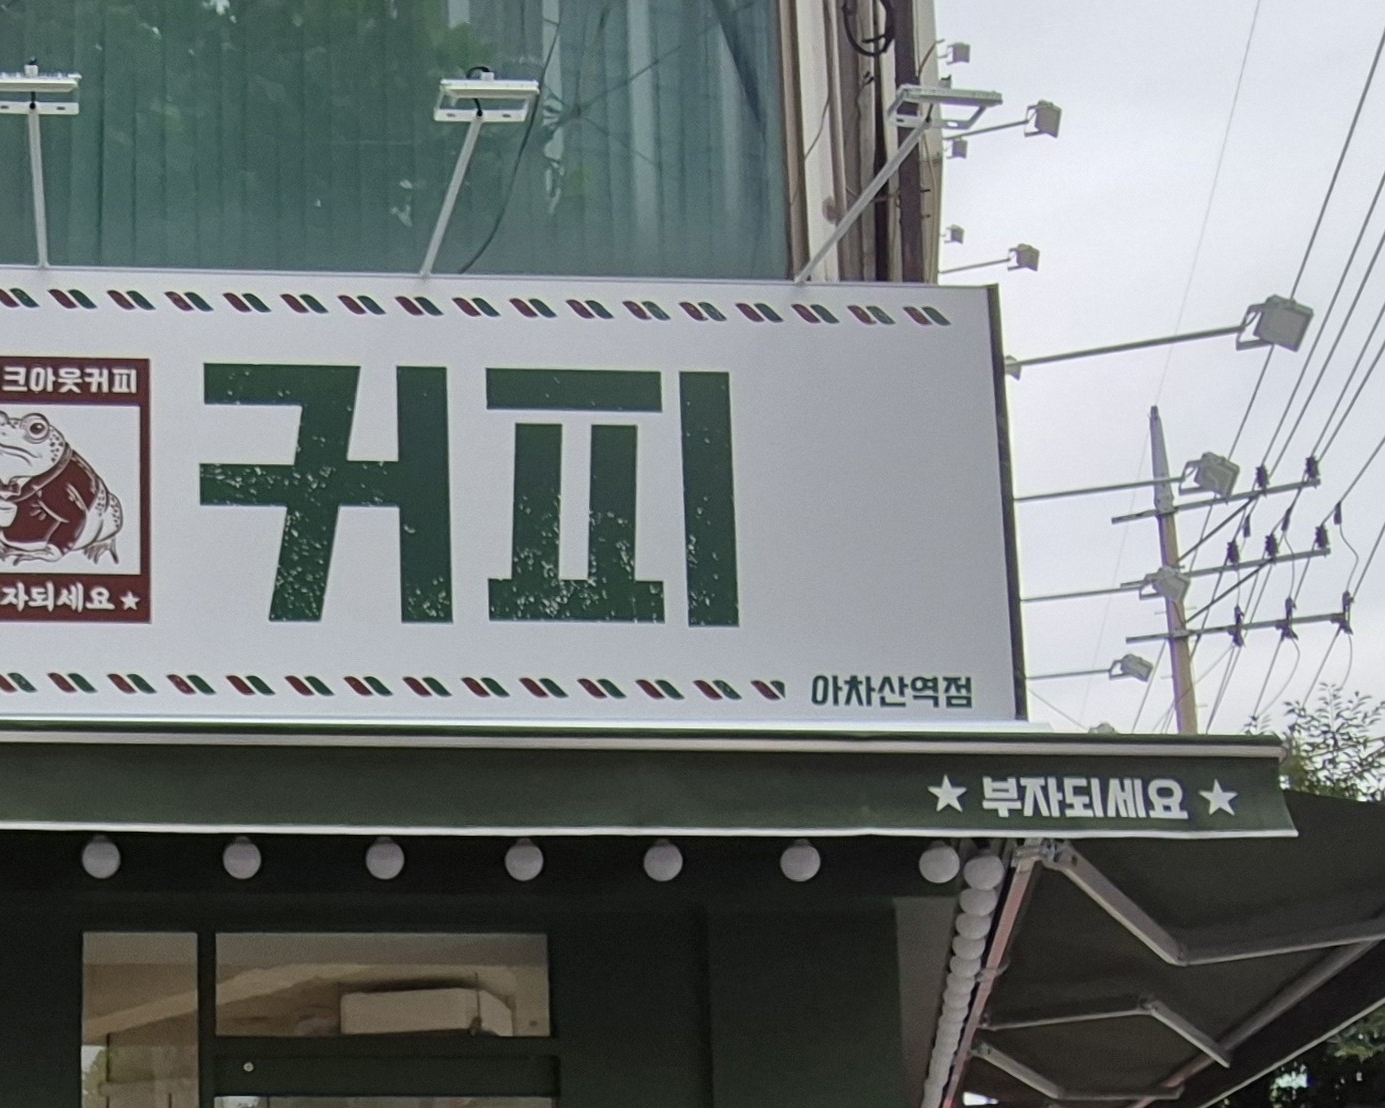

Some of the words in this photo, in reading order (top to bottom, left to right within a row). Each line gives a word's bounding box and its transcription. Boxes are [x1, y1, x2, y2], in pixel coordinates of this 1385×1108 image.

[198, 362, 740, 627] 커피
[811, 675, 973, 708] 아차산역점
[981, 776, 1189, 820] 부자되세요
